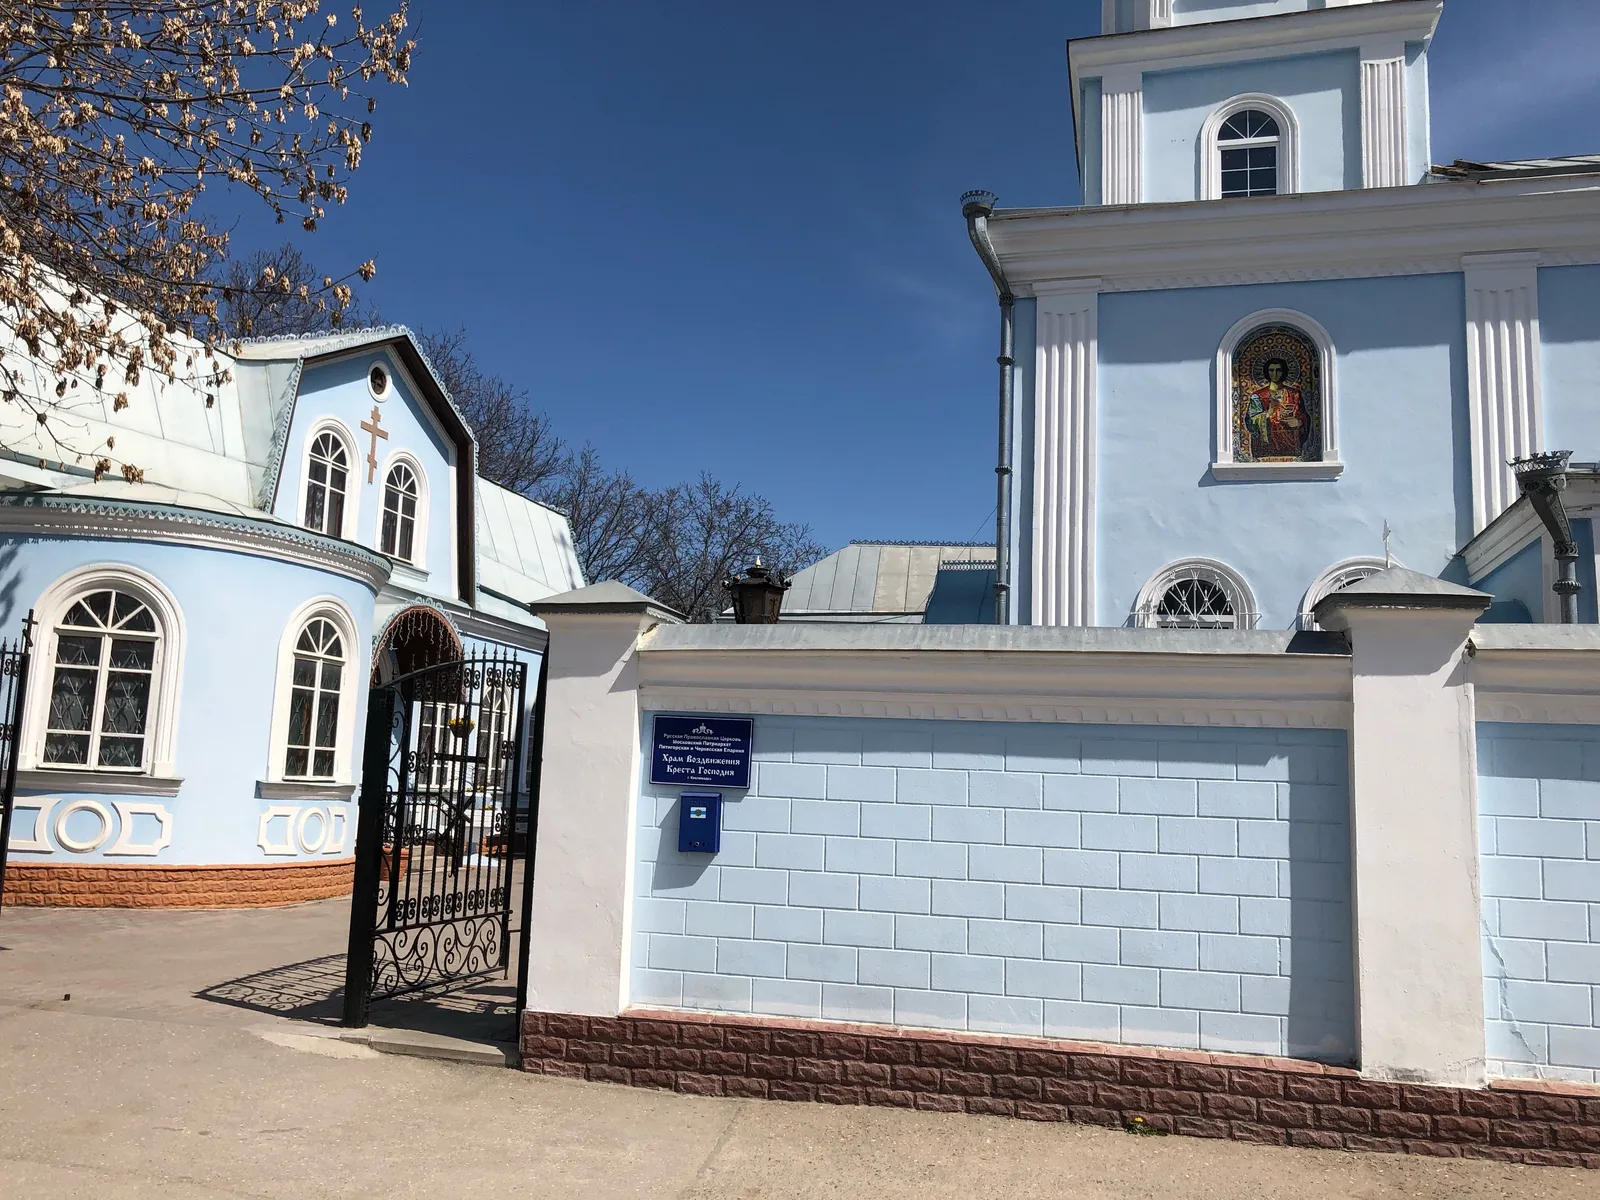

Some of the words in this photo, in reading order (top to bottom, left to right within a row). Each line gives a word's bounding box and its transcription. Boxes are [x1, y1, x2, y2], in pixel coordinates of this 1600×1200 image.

[662, 753, 684, 763] Храм
[686, 755, 740, 765] Воздвижения
[667, 765, 695, 774] Креста
[699, 766, 735, 777] Господня
